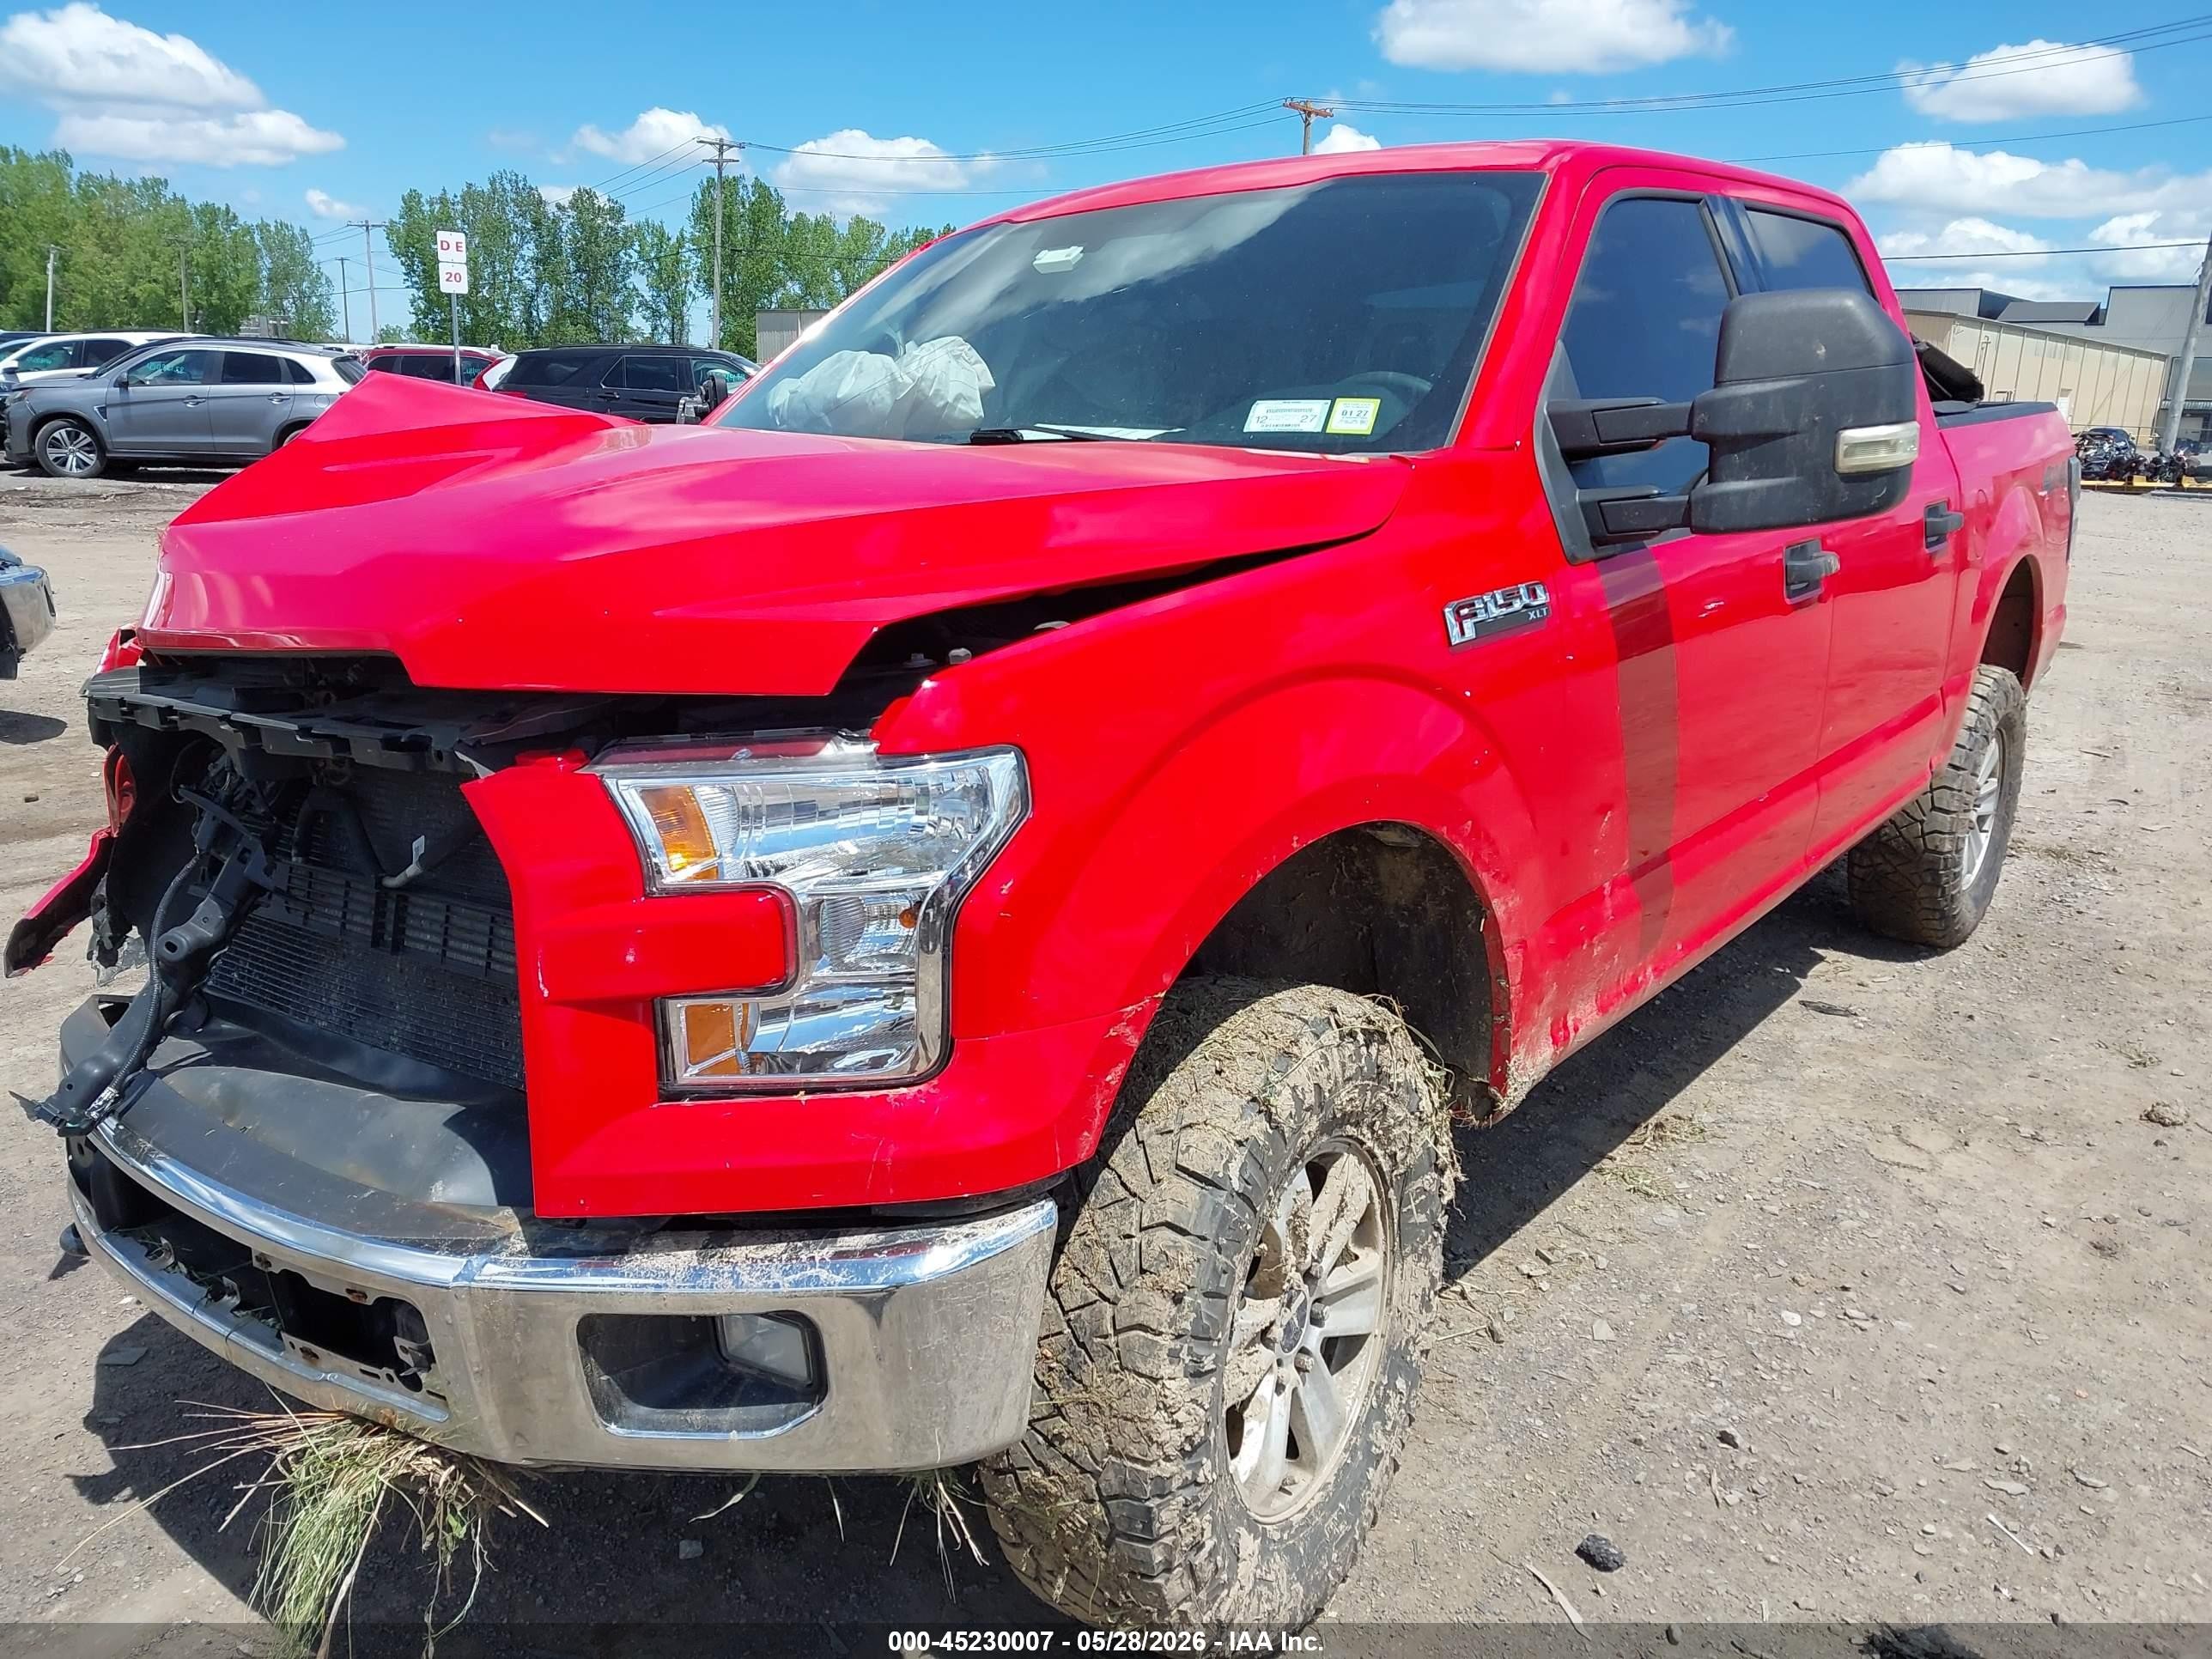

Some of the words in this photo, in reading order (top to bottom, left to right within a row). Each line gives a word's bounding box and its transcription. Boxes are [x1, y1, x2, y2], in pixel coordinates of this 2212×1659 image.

[440, 240, 451, 252] D
[455, 241, 464, 252] E
[445, 271, 462, 283] 20
[1255, 416, 1268, 424] 12
[1300, 414, 1318, 423] 27
[1528, 606, 1549, 621] XLT
